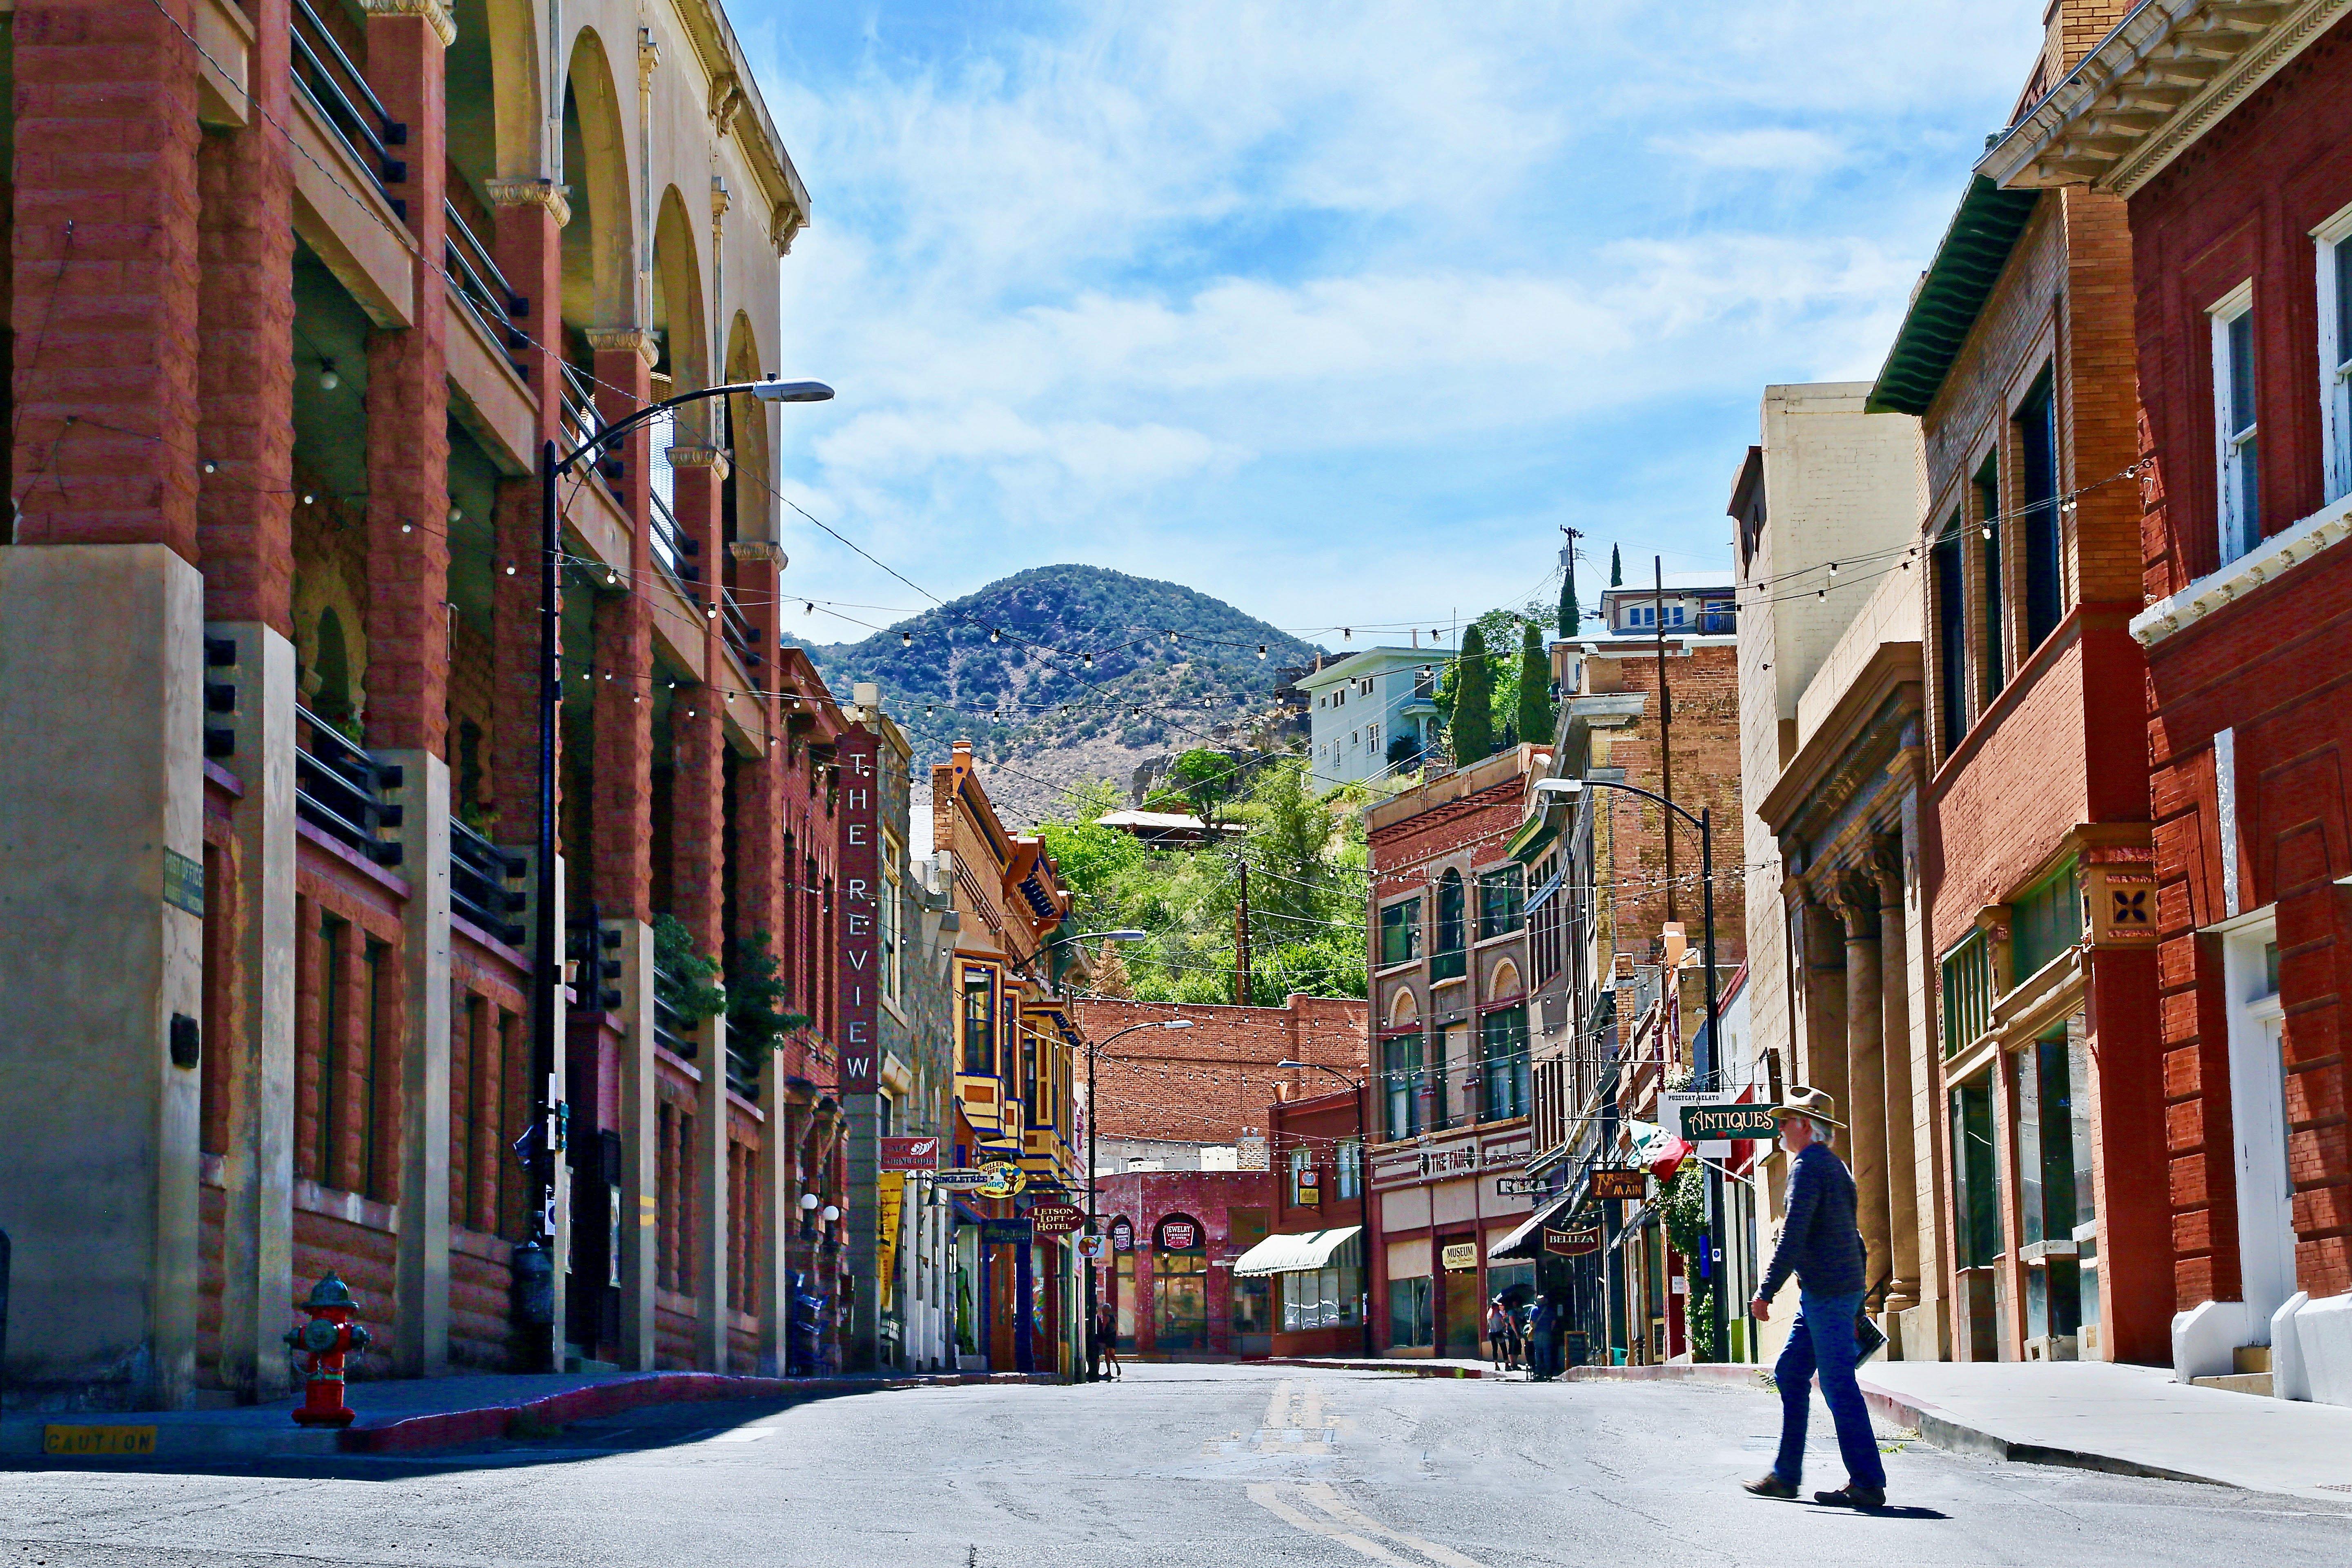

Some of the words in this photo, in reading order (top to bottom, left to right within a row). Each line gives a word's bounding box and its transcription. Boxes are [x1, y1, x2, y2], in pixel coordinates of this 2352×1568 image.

[849, 753, 866, 846] THE
[182, 859, 203, 888] OFFICE
[847, 879, 869, 1079] REVIEW
[1688, 1111, 1774, 1135] ANTIQUES
[982, 1161, 1004, 1172] KILLER
[1431, 1152, 1446, 1173] THE
[1450, 1148, 1466, 1170] FAIR
[933, 1175, 987, 1184] SINGLETREE
[985, 1178, 1005, 1189] oney
[1614, 1185, 1641, 1195] MAIN
[1034, 1207, 1073, 1216] LETSON
[1167, 1226, 1190, 1234] JEWELRY
[1447, 1246, 1473, 1258] MUSEUM
[47, 1433, 150, 1451] CAUTION
